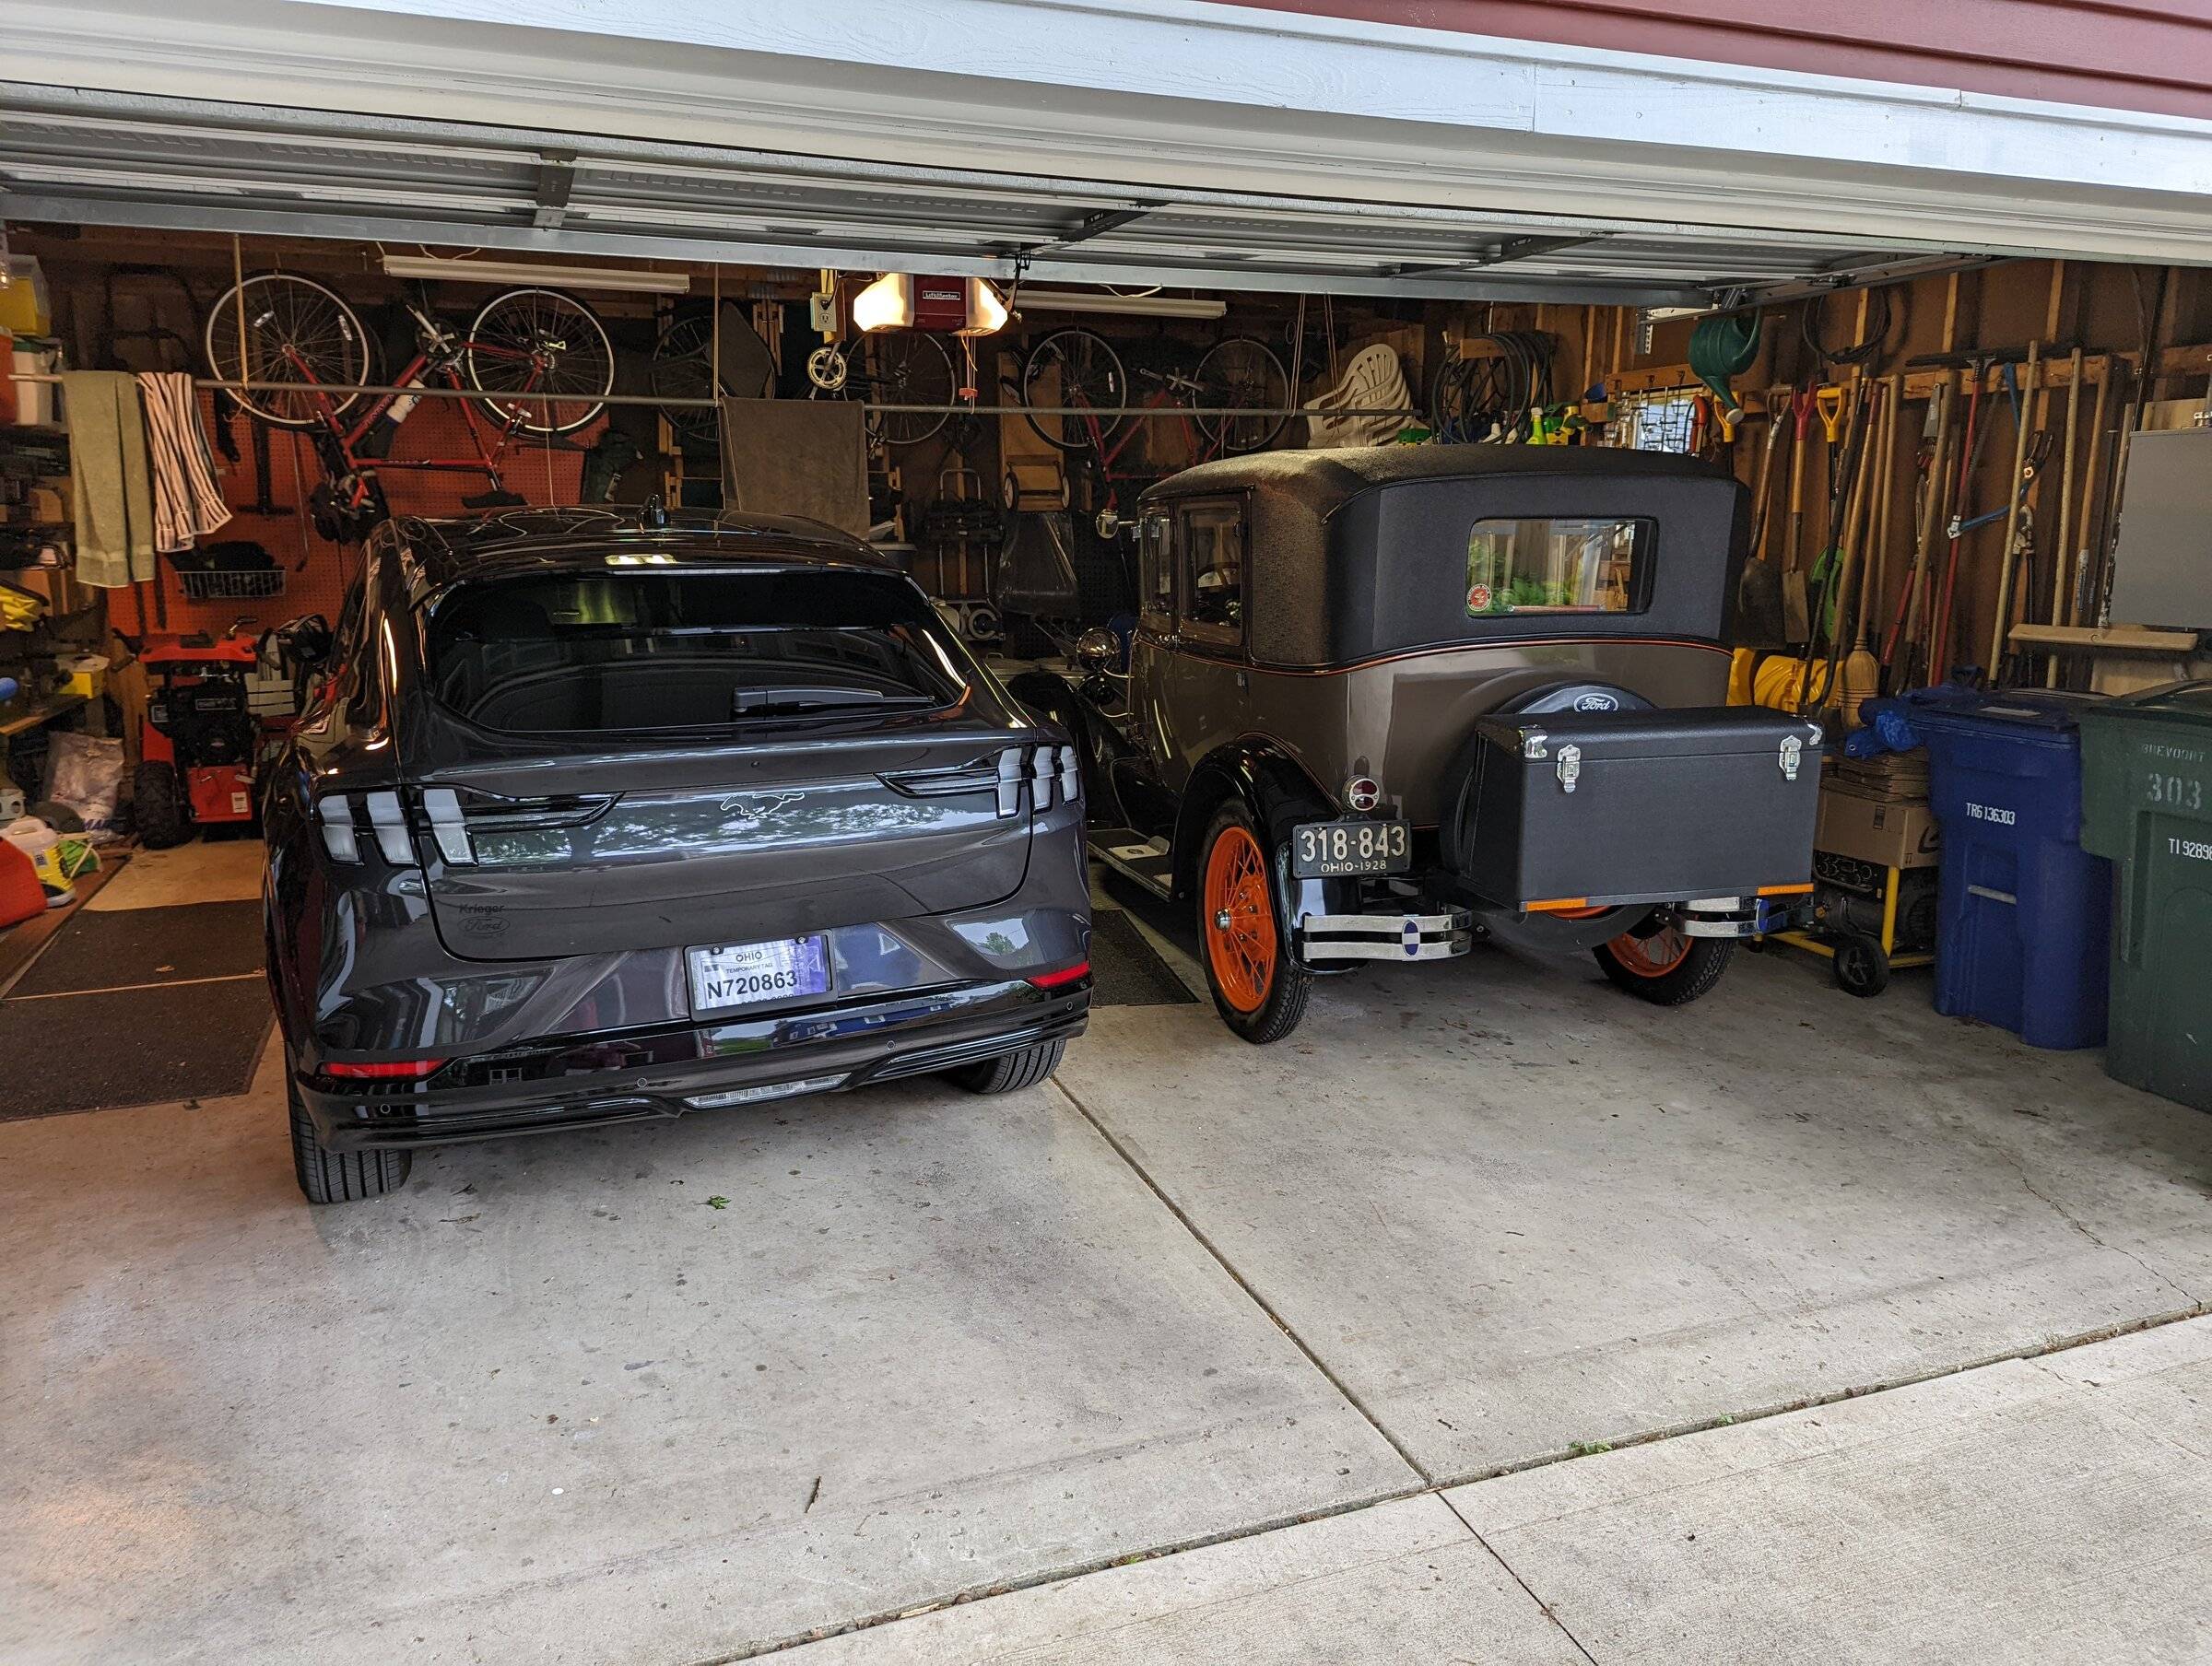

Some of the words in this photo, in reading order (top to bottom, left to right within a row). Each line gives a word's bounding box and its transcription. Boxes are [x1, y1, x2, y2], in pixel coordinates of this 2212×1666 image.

[1581, 697, 1611, 710] Ford
[2147, 773, 2202, 810] 303
[1300, 826, 1406, 862] 318-843
[1321, 860, 1387, 873] OHIO-1928
[459, 903, 505, 915] Krieger
[735, 951, 762, 962] OHIO
[725, 964, 760, 974] TEMPORARY
[707, 969, 798, 1000] N720863
